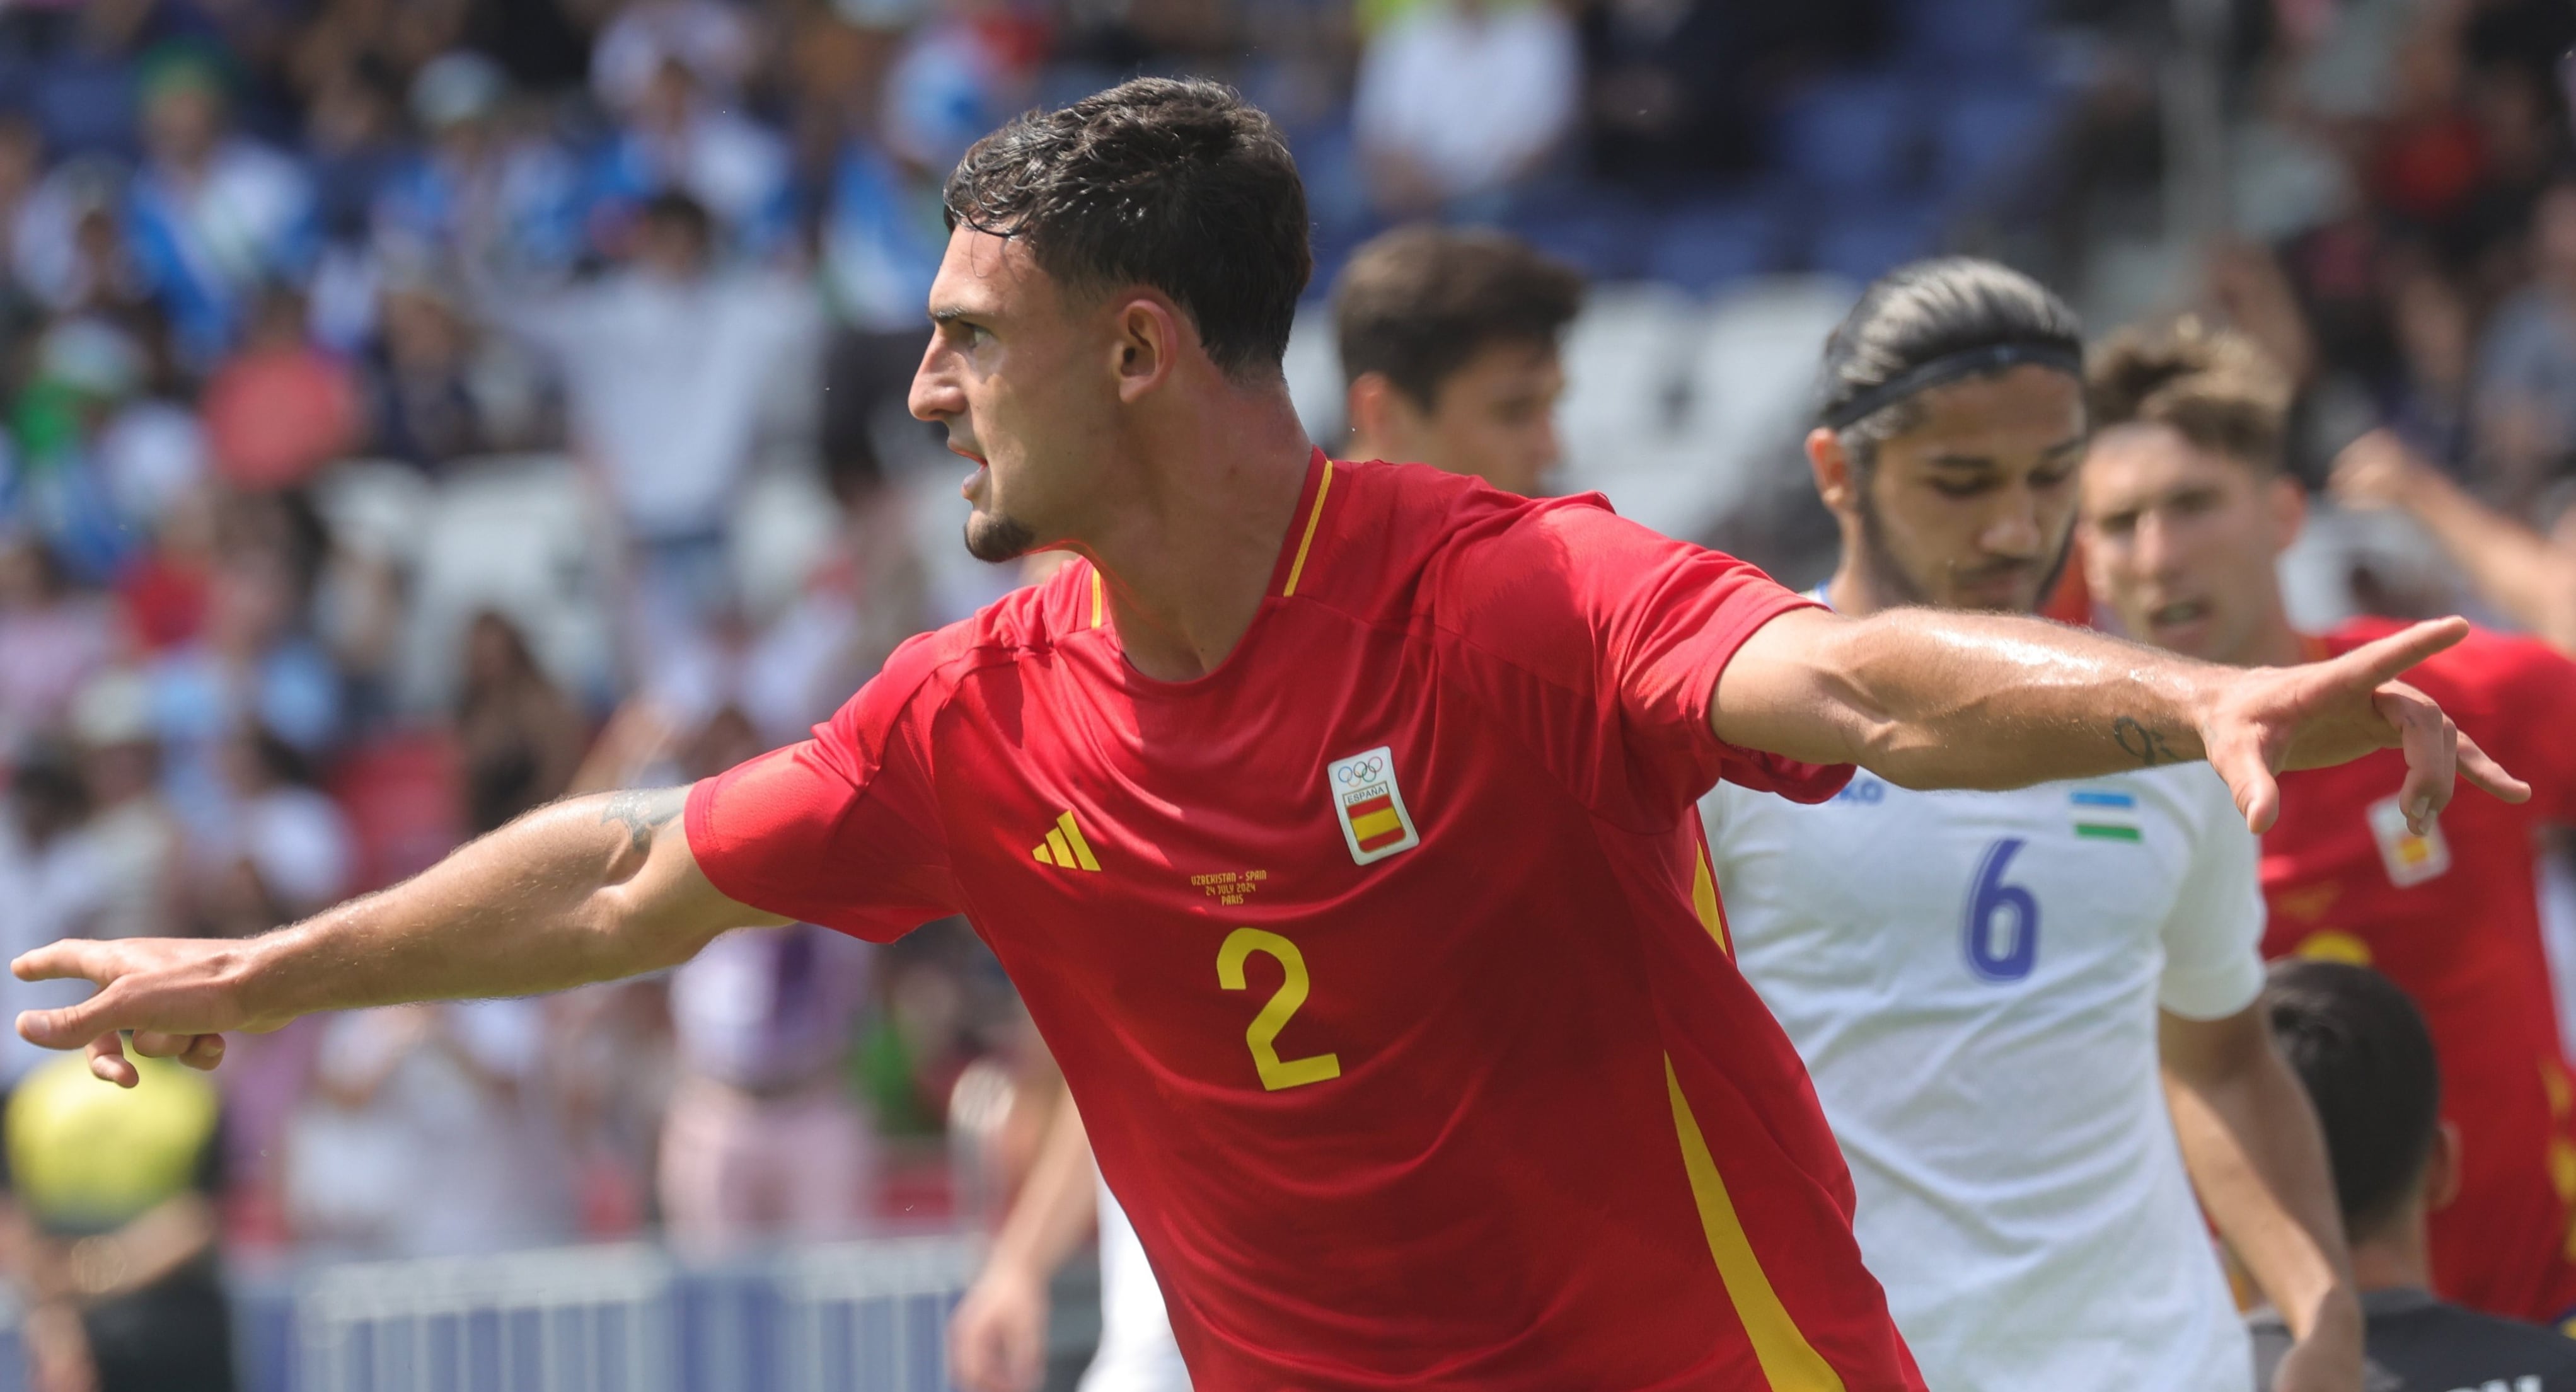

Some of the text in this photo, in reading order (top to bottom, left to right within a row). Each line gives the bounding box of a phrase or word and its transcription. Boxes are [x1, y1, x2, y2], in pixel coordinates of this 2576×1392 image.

[1347, 785, 1385, 803] ESPAÑA
[1191, 872, 1236, 887] UZBEKISTAN
[1245, 870, 1267, 882] SPAIN
[1206, 882, 1256, 896] 24 JULY 2024
[1222, 894, 1244, 906] PARIS
[1965, 837, 2040, 982] 6
[1216, 928, 1341, 1091] 2
